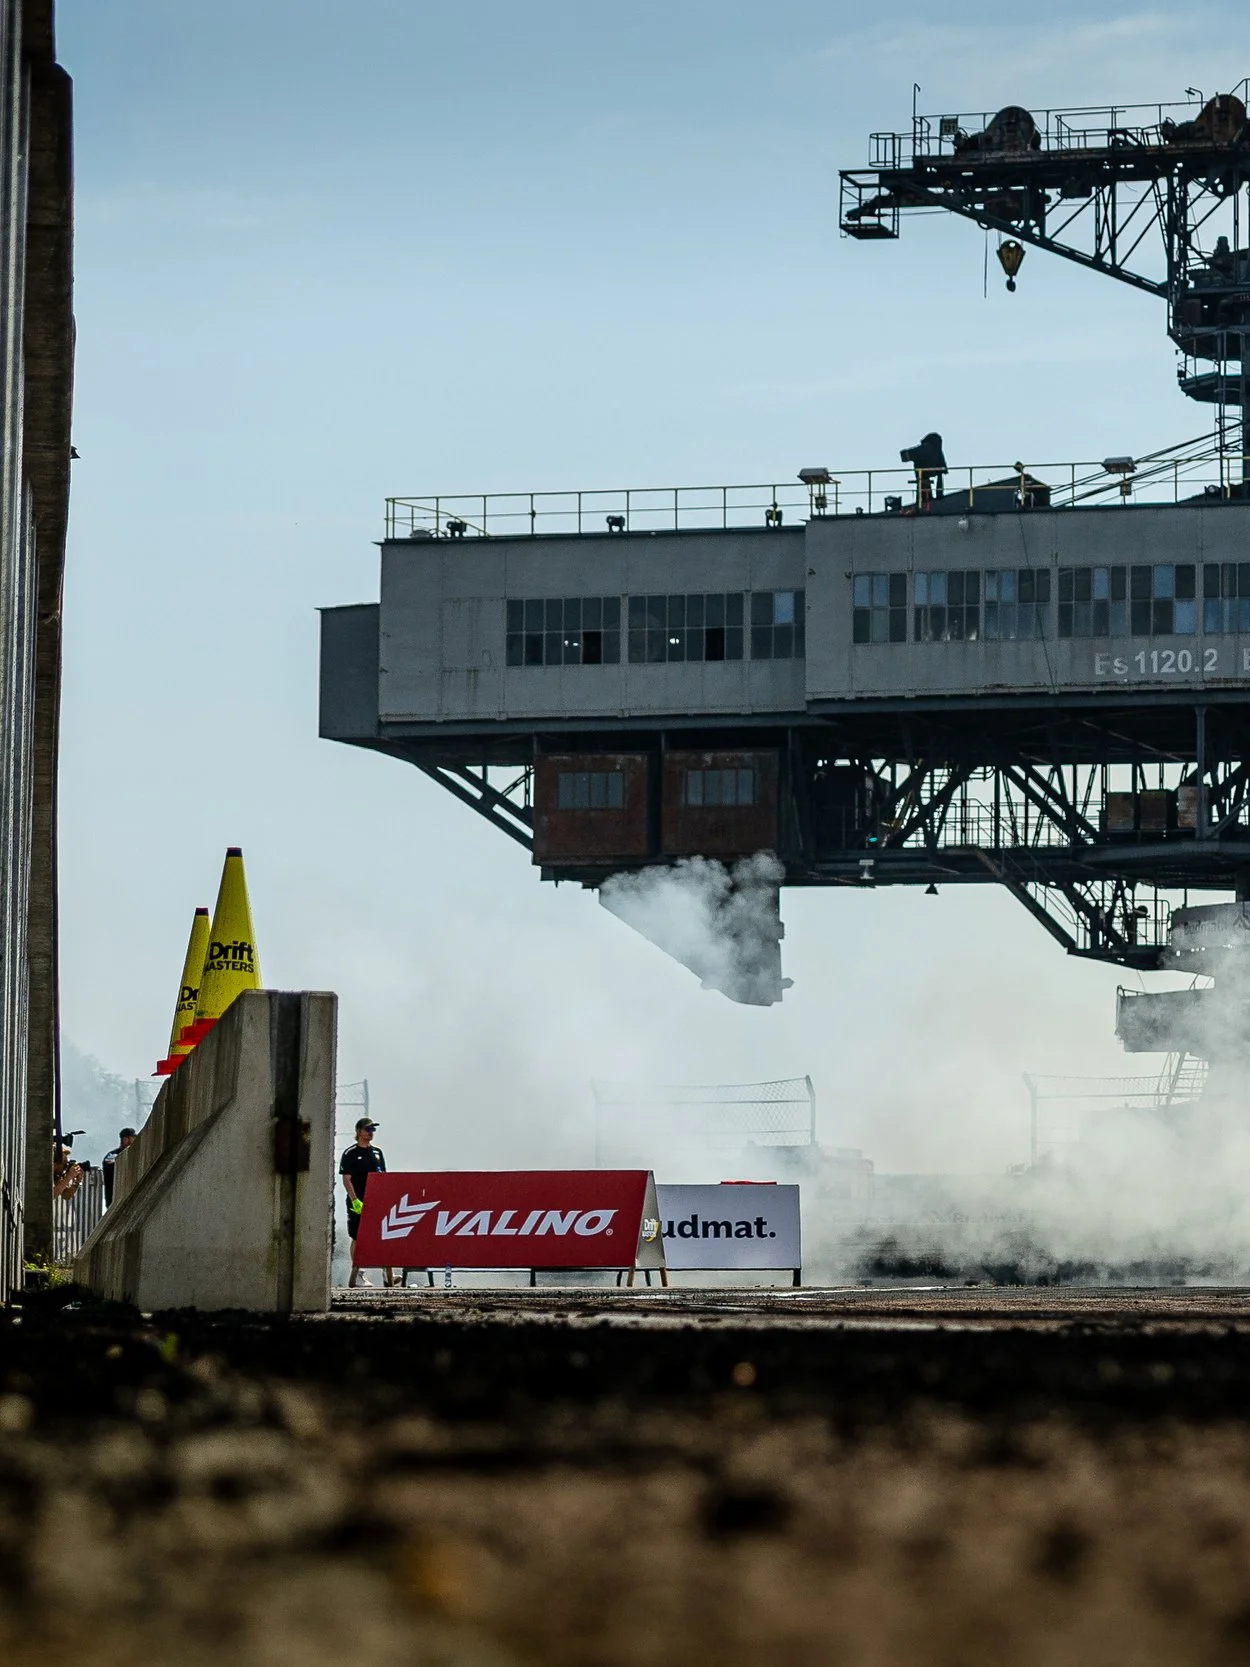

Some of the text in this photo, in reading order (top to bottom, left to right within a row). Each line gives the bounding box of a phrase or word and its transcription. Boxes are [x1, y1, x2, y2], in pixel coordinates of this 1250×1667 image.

[1135, 648, 1218, 674] 1120.2
[209, 940, 254, 962] Drift
[435, 1209, 619, 1236] VALINO
[660, 1214, 776, 1238] udmat.
